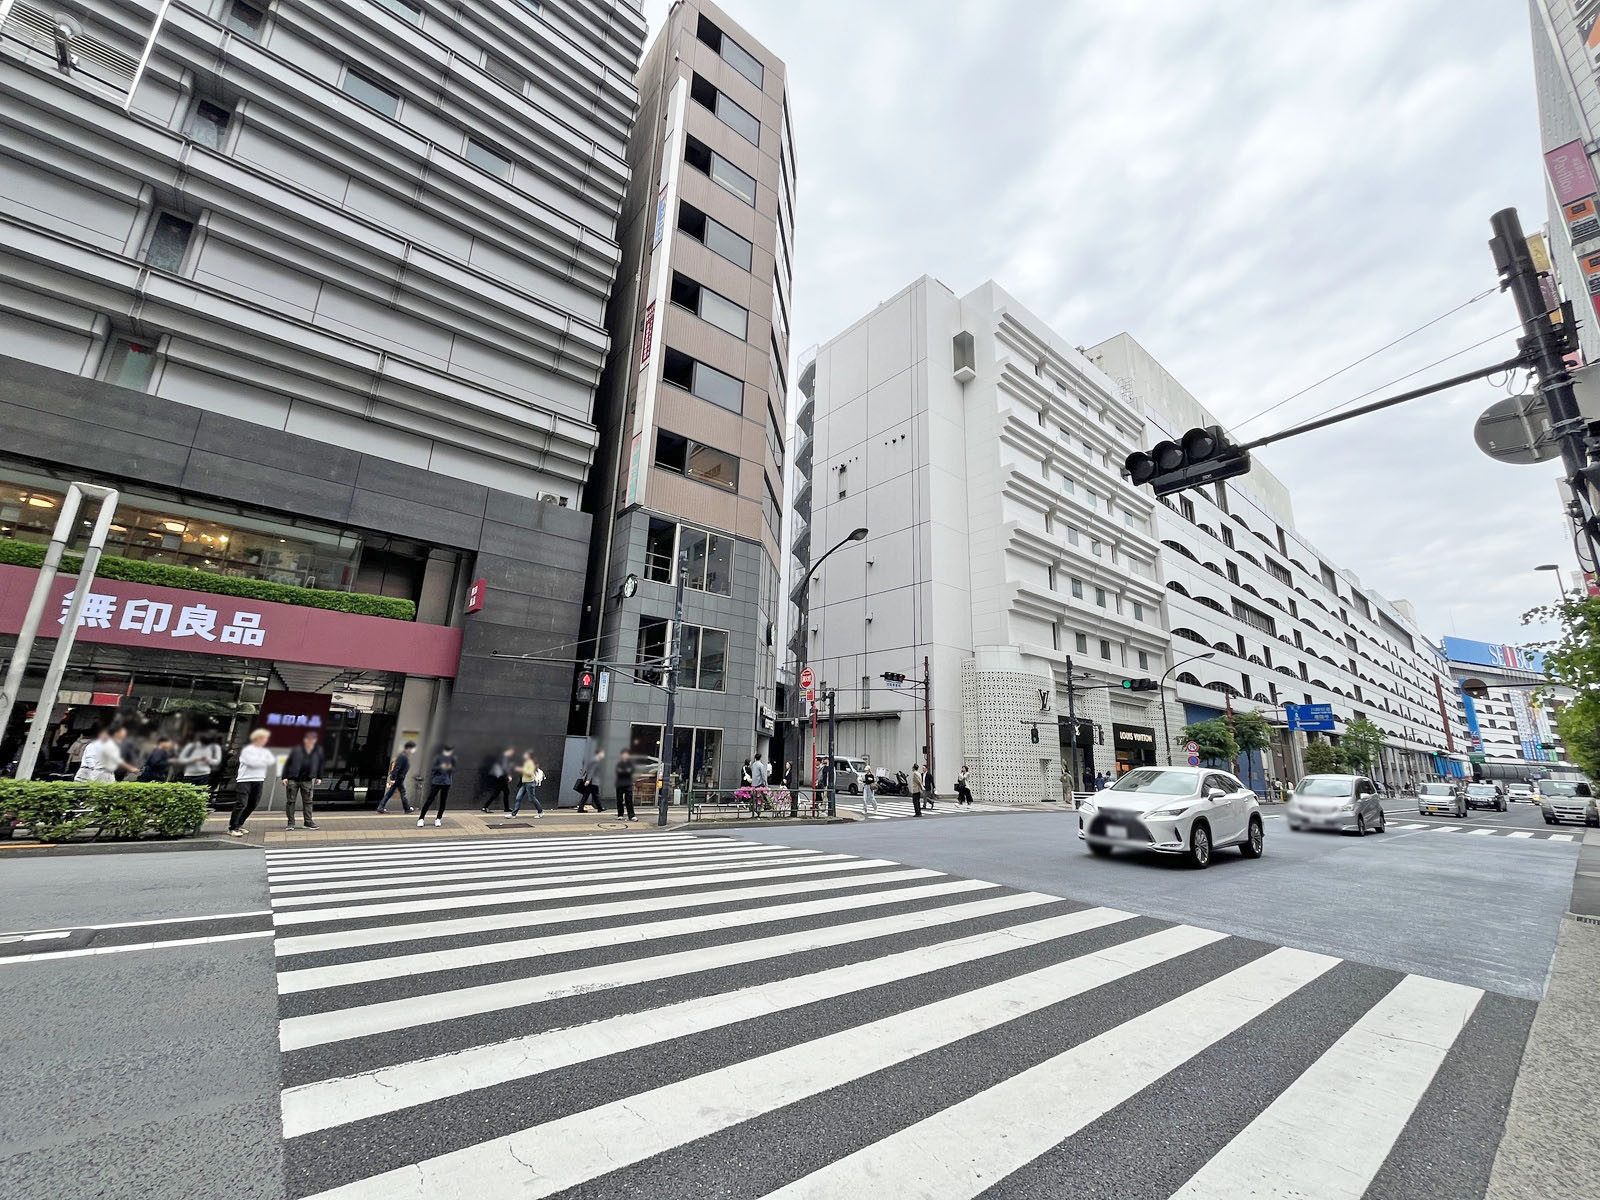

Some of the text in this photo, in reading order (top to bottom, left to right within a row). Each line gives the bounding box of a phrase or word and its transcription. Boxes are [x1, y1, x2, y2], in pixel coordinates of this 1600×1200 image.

[57, 590, 266, 647] 無印良品
[266, 712, 323, 728] 無印良品
[1119, 731, 1153, 743] LOUIS VUITTON
